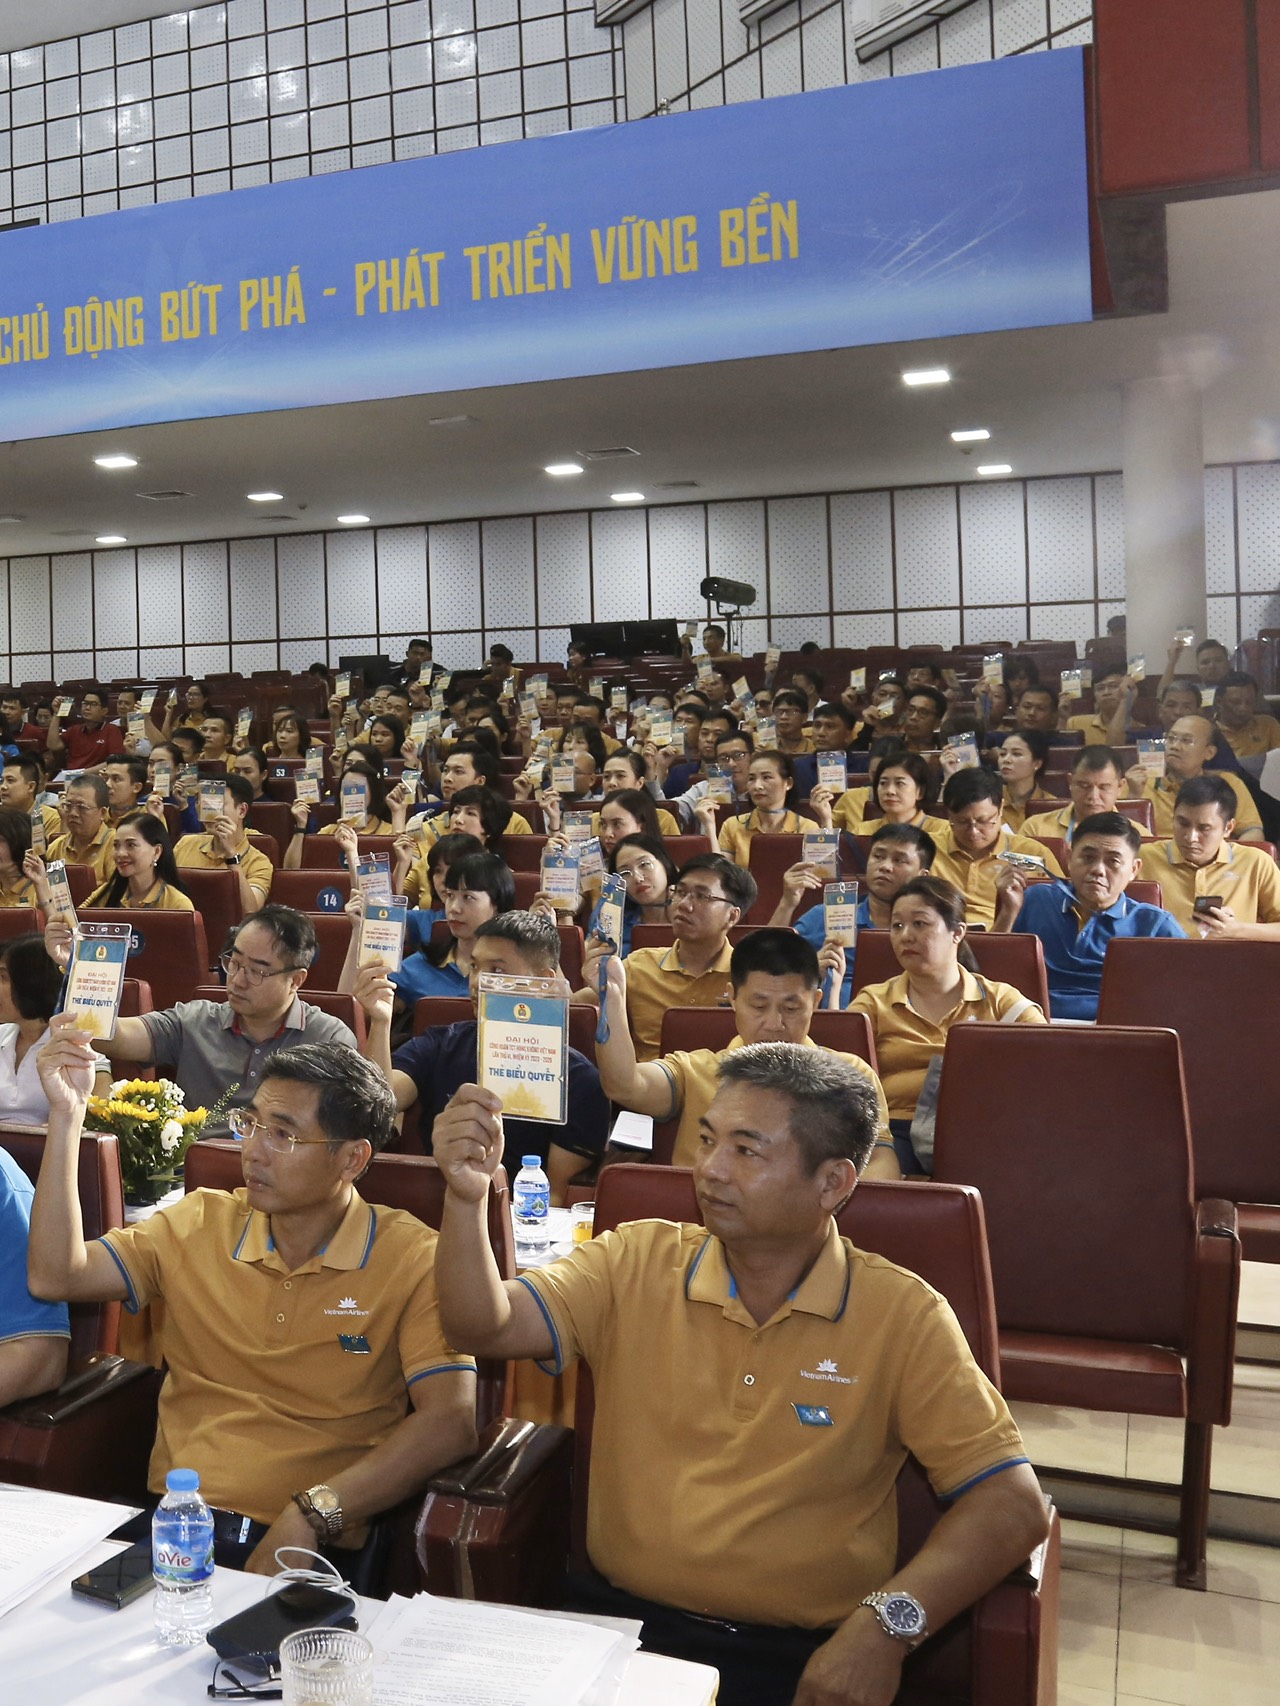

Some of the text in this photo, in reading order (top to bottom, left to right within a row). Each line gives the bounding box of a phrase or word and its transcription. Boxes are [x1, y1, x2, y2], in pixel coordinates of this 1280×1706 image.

[63, 297, 145, 359] ĐỘNG
[161, 281, 223, 343] BỨT
[240, 266, 306, 331] PHÁ
[355, 249, 446, 316] PHÁT
[464, 223, 572, 301] TRIỂN
[591, 215, 699, 284] VỮNG
[719, 192, 799, 268] BỀN
[276, 768, 286, 777] 53
[324, 894, 338, 906] 14
[128, 935, 139, 948] 5
[489, 1064, 555, 1082] THẺ BIỂU QUYẾT
[155, 1550, 192, 1567] aVie
